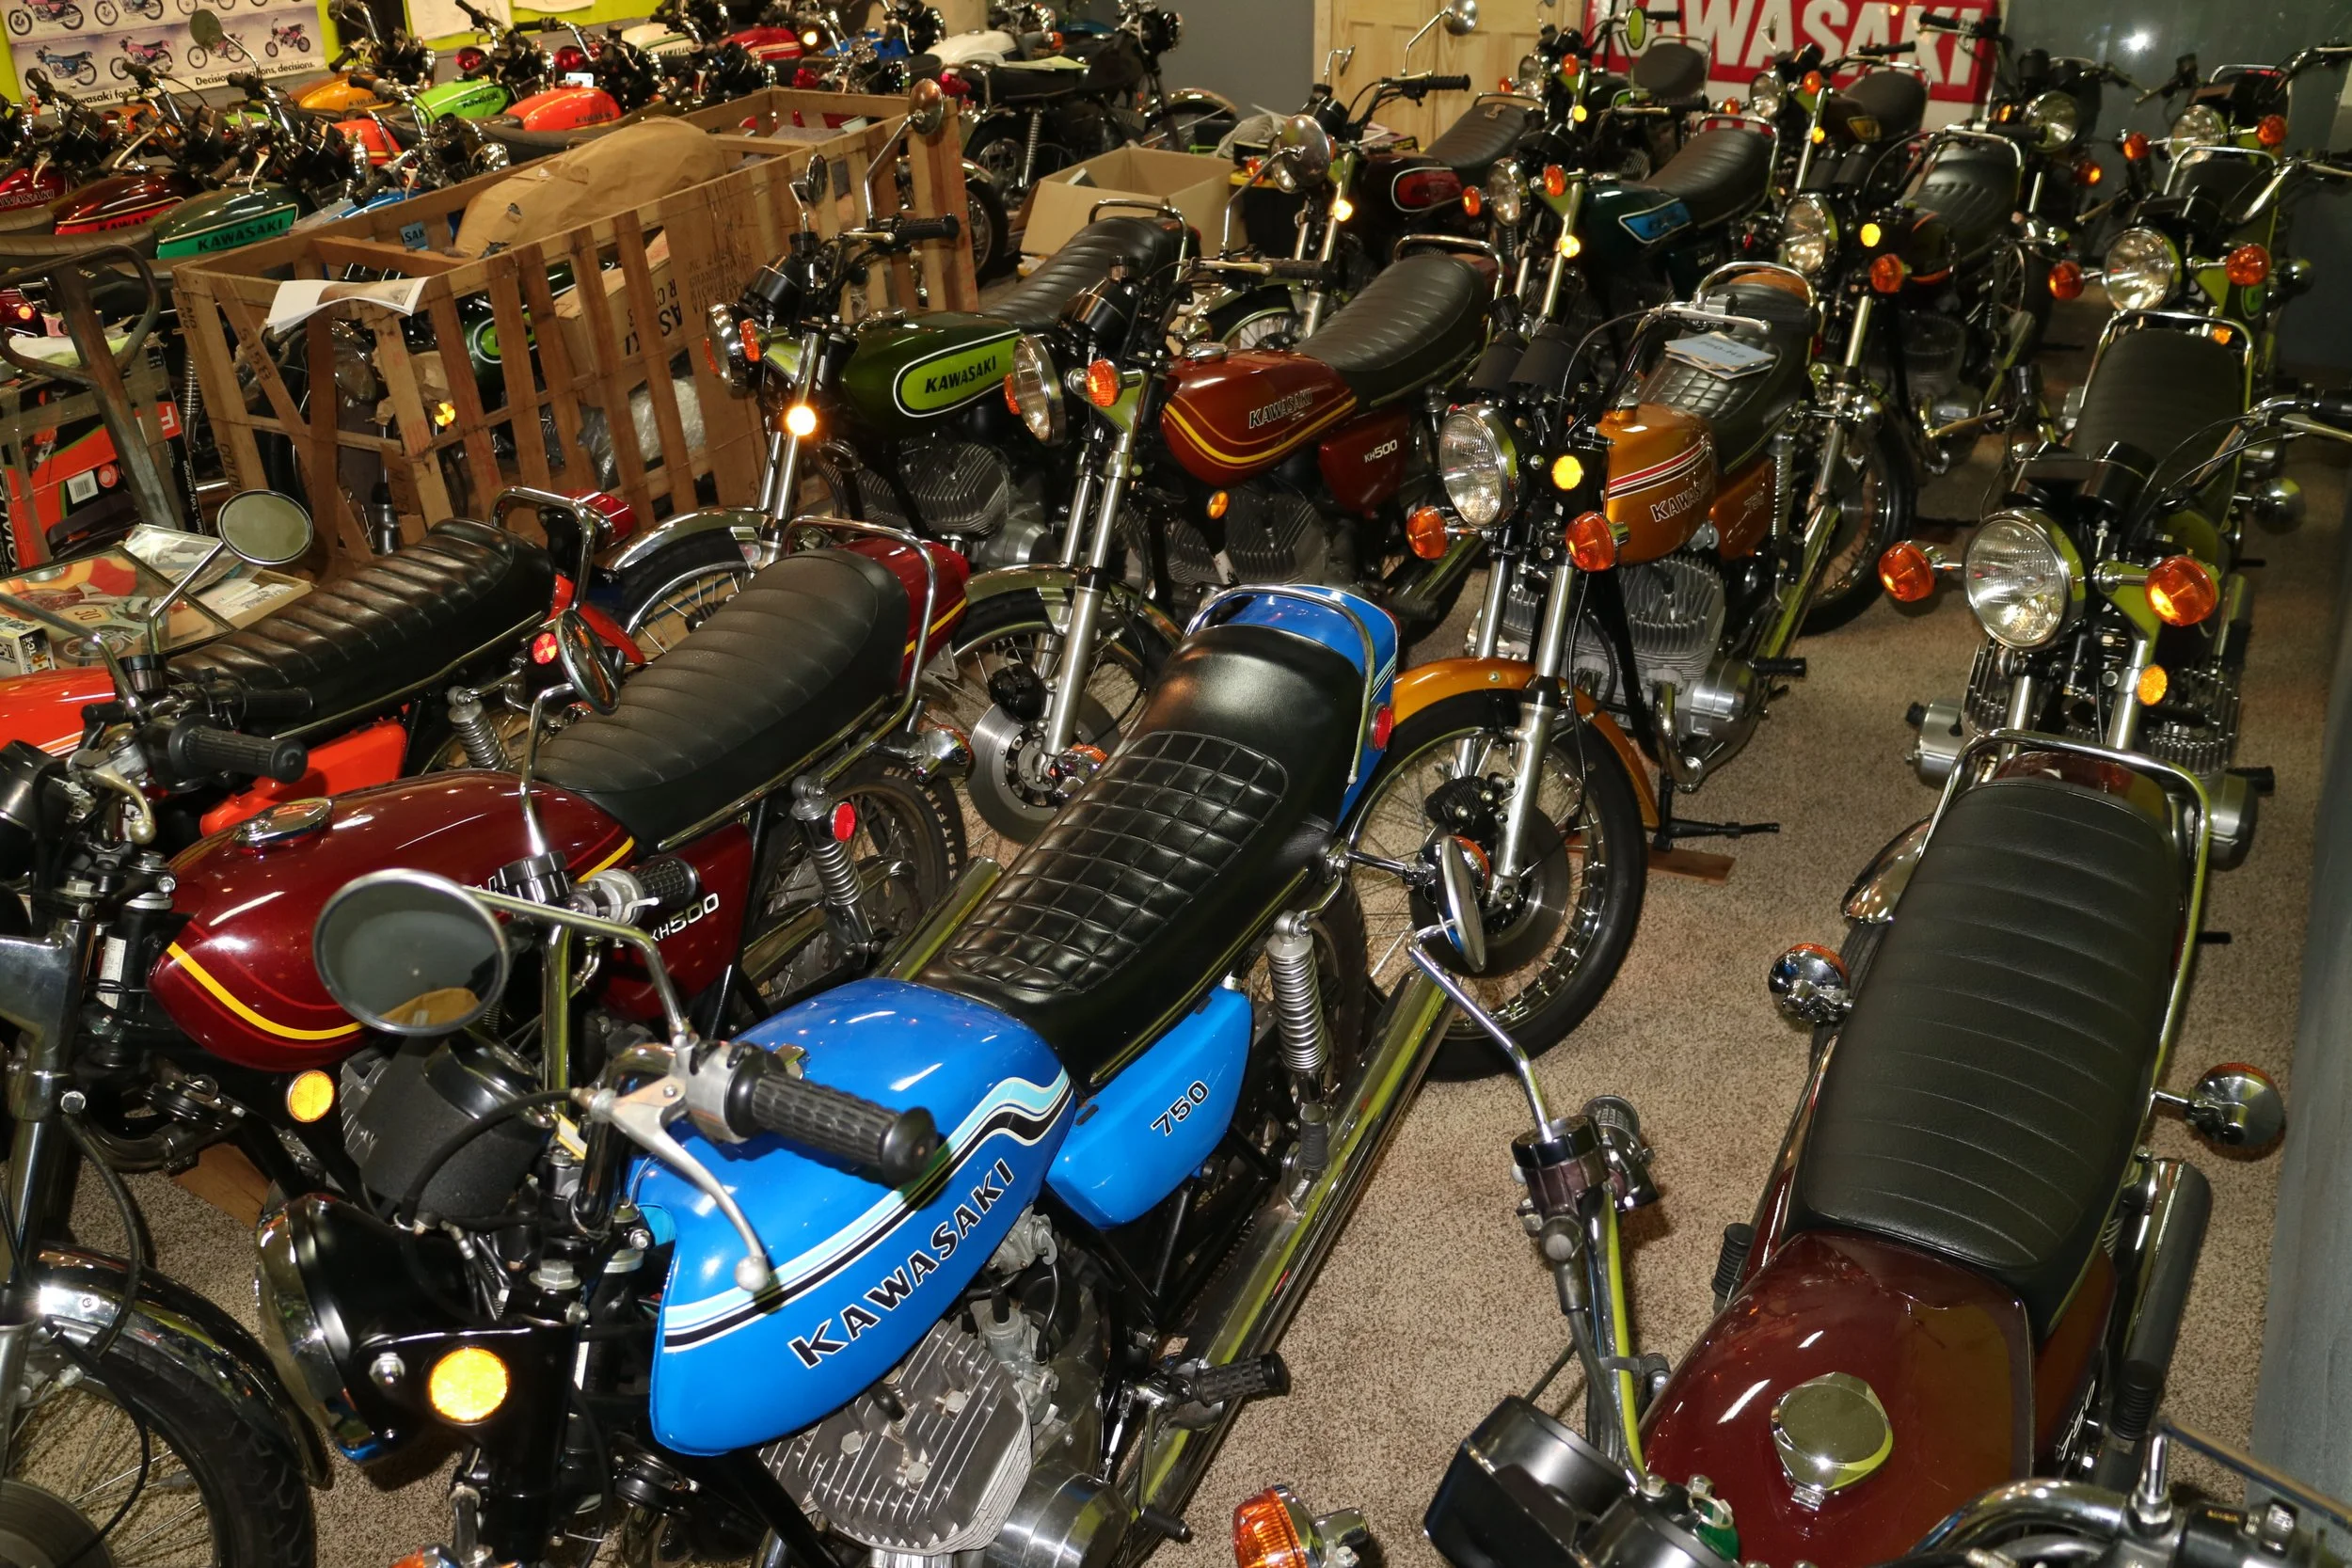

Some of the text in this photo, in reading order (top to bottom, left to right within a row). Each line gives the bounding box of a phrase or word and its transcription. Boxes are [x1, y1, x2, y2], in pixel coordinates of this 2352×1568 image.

[277, 60, 316, 74] decisions.
[72, 89, 112, 106] wasaki
[0, 189, 56, 208] AWASAKI
[197, 217, 283, 252] KAWASAKI
[925, 356, 997, 394] KAWASAKI
[1248, 388, 1313, 430] KAWASAKI
[1364, 439, 1398, 464] KH500
[1649, 483, 1703, 523] KAWAS
[650, 893, 720, 942] KH500
[1150, 1079, 1211, 1137] 750
[787, 1157, 1016, 1370] KAWASAKI
[2055, 1379, 2096, 1462] 750
